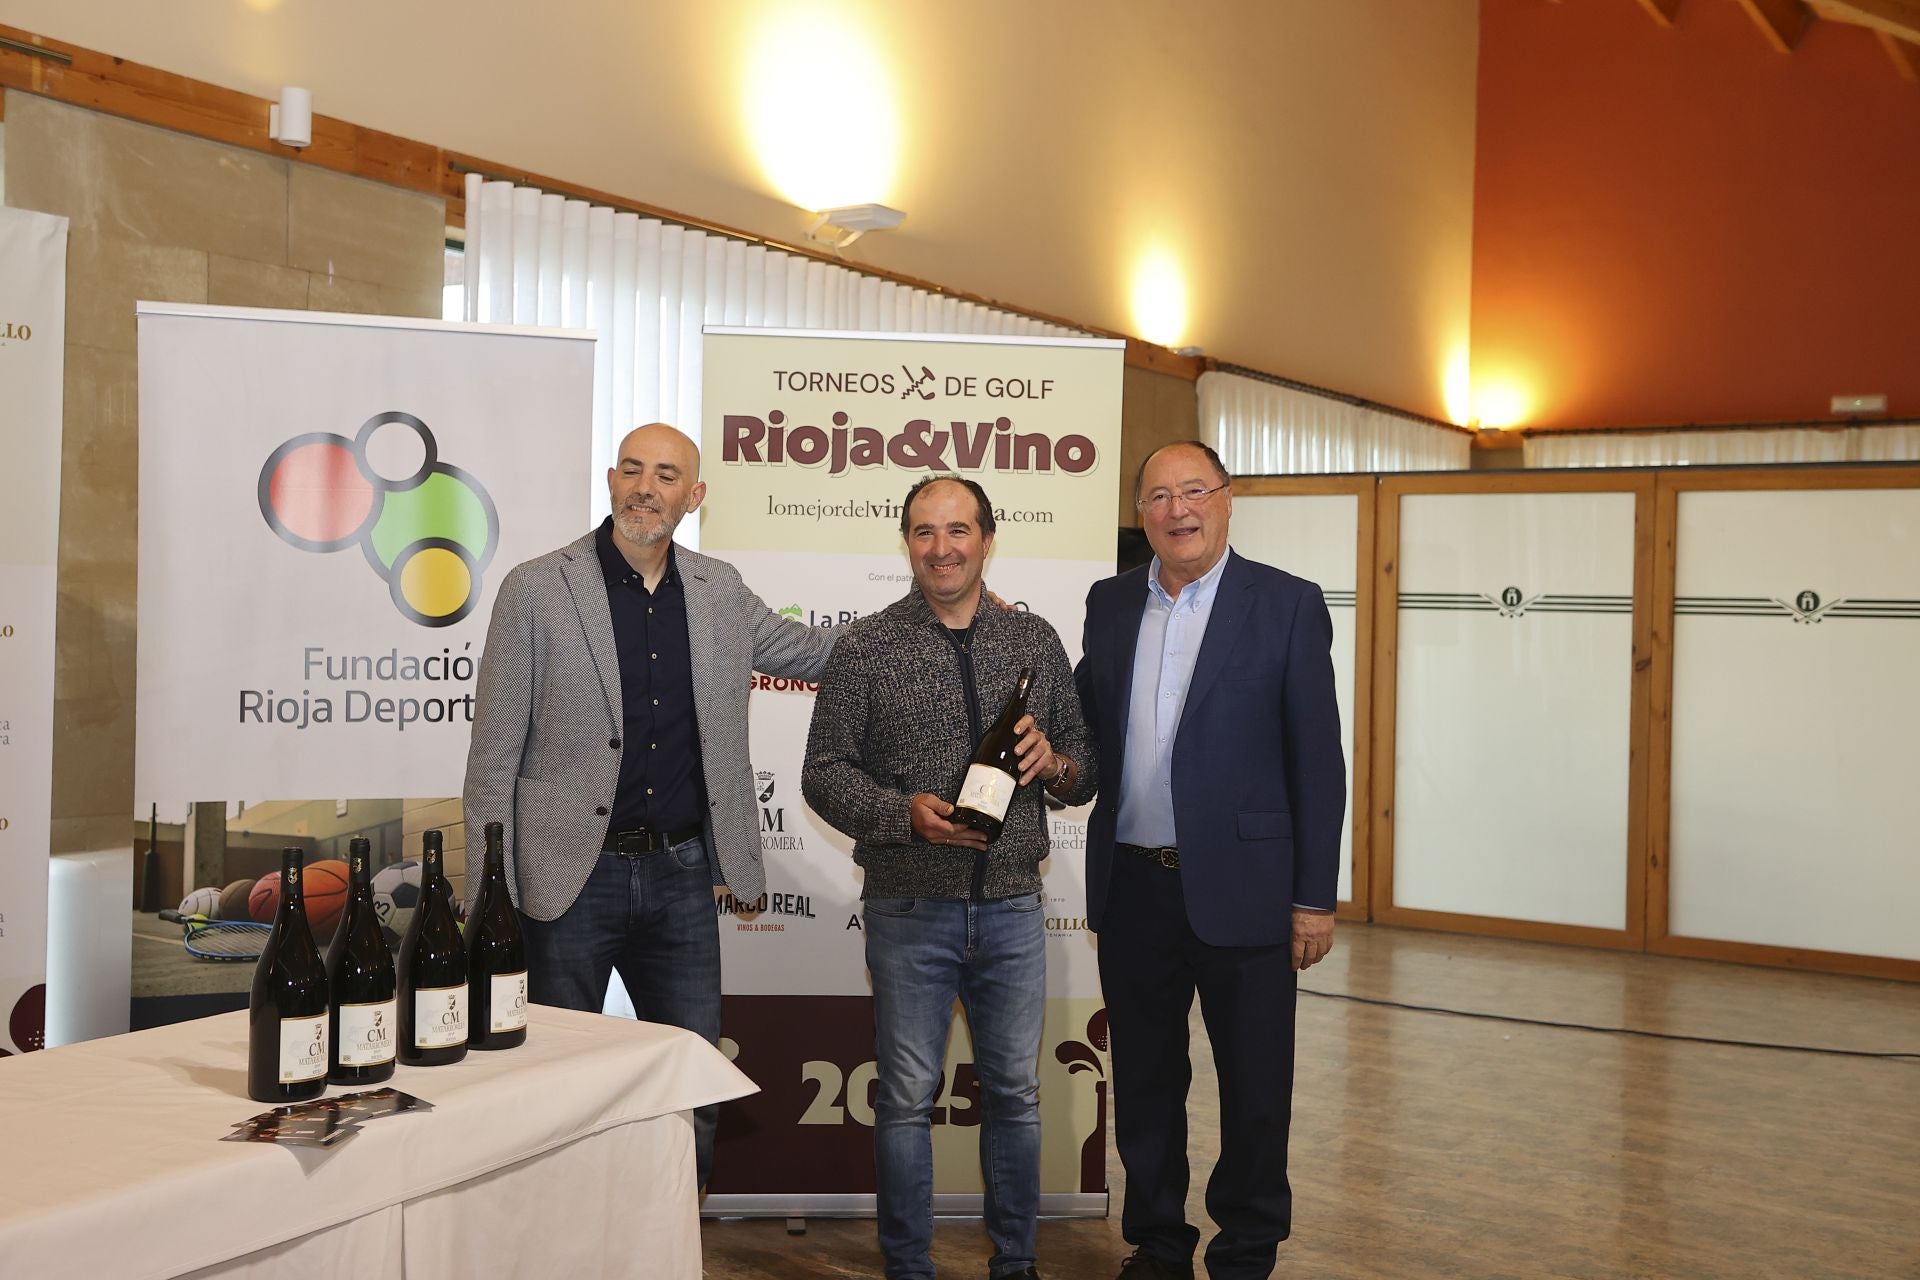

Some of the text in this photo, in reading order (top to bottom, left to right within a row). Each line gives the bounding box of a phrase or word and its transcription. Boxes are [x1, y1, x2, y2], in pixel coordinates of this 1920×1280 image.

[773, 371, 1054, 400] TORNEOS DE GOLF
[722, 410, 1099, 477] Rioja&Vino
[868, 572, 885, 582] Con
[304, 642, 480, 681] Fundació
[239, 689, 476, 731] Rioja Deport
[761, 807, 784, 832] M
[1052, 821, 1086, 835] Finc
[773, 892, 816, 919] REAL
[737, 924, 753, 932] VINOS
[761, 924, 785, 932] BODEGAS
[442, 1011, 460, 1025] CM
[367, 1027, 386, 1043] CM
[309, 1041, 325, 1057] CM
